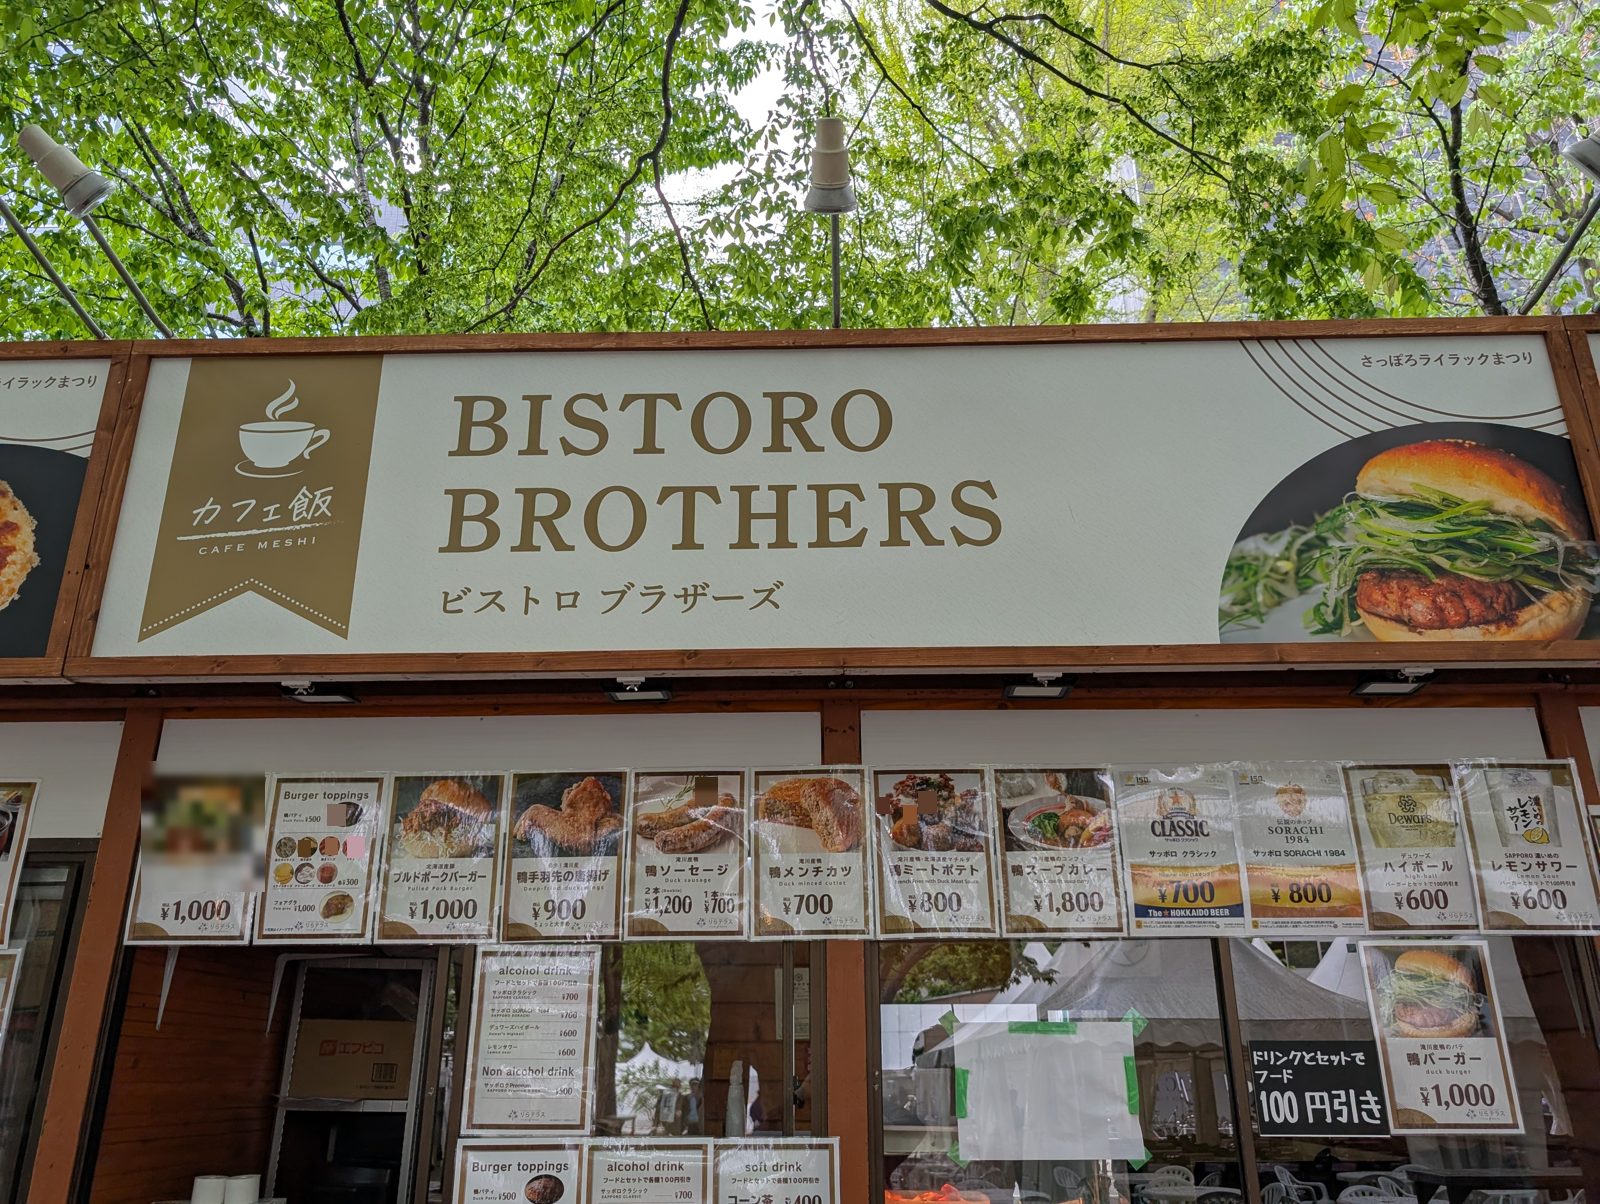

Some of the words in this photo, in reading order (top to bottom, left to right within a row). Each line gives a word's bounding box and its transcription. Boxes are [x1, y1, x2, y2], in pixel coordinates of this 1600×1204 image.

[1360, 351, 1533, 368] さっぽろライラックまつり
[0, 375, 98, 390] イラックまつり
[447, 388, 893, 457] BISTORO
[192, 485, 334, 527] カフェ飯
[438, 479, 1002, 554] BROTHERS
[198, 542, 246, 555] CAFE
[257, 536, 317, 550] MESHI
[441, 586, 581, 615] ビストロ
[600, 580, 784, 614] ブラザーズ
[283, 790, 319, 801] Burger
[322, 790, 369, 801] toppings
[1506, 806, 1520, 831] サワー
[1516, 798, 1532, 829] レモン
[1150, 820, 1210, 838] CLASSIC
[1267, 826, 1324, 835] SORACHI
[1284, 835, 1310, 844] 1984
[1149, 849, 1178, 858] サッポロ
[1182, 849, 1217, 858] クラシック
[1252, 849, 1282, 858] サッポロ
[1283, 849, 1322, 857] SORACHI
[1324, 849, 1346, 857] 1984
[645, 864, 729, 877] 鴨ソーセージ
[769, 866, 852, 879] 鴨メンチカツ
[1011, 864, 1107, 877] 鴨スープカレー
[1384, 860, 1453, 873] ハイボール
[1491, 860, 1578, 872] レモンサワー
[1158, 880, 1216, 904] ¥700
[1394, 888, 1449, 910] ¥600
[1511, 888, 1567, 910] ¥600
[532, 898, 587, 920] ¥900
[704, 897, 735, 914] ¥700
[783, 893, 833, 915] ¥700
[908, 891, 962, 913] ¥800
[1034, 891, 1104, 916] ¥1,800
[160, 899, 231, 924] ¥1,000
[408, 898, 478, 923] ¥1,000
[1148, 909, 1163, 917] The
[1170, 908, 1210, 917] HOKKAIDO
[1210, 908, 1230, 917] BEER
[499, 966, 540, 976] alcohol
[543, 965, 573, 976] drink
[1252, 1050, 1365, 1066] ドリンクとセットで
[1406, 1052, 1482, 1066] 鴨バーガー
[482, 1066, 503, 1077] Non
[506, 1066, 544, 1077] alcohol
[547, 1066, 574, 1077] drink
[1254, 1068, 1294, 1084] フード
[1420, 1083, 1496, 1110] ¥1,000
[1260, 1089, 1299, 1124] 100
[1304, 1088, 1382, 1125] 円引き
[472, 1161, 513, 1174] Burger
[517, 1161, 569, 1174] toppings
[607, 1161, 650, 1172] alcohol
[654, 1161, 685, 1172] drink
[745, 1162, 768, 1173] soft
[772, 1161, 802, 1173] drink
[603, 1176, 691, 1184] フードとセットで各種100円引き
[498, 1192, 517, 1201] ¥500
[675, 1190, 693, 1200] ¥700
